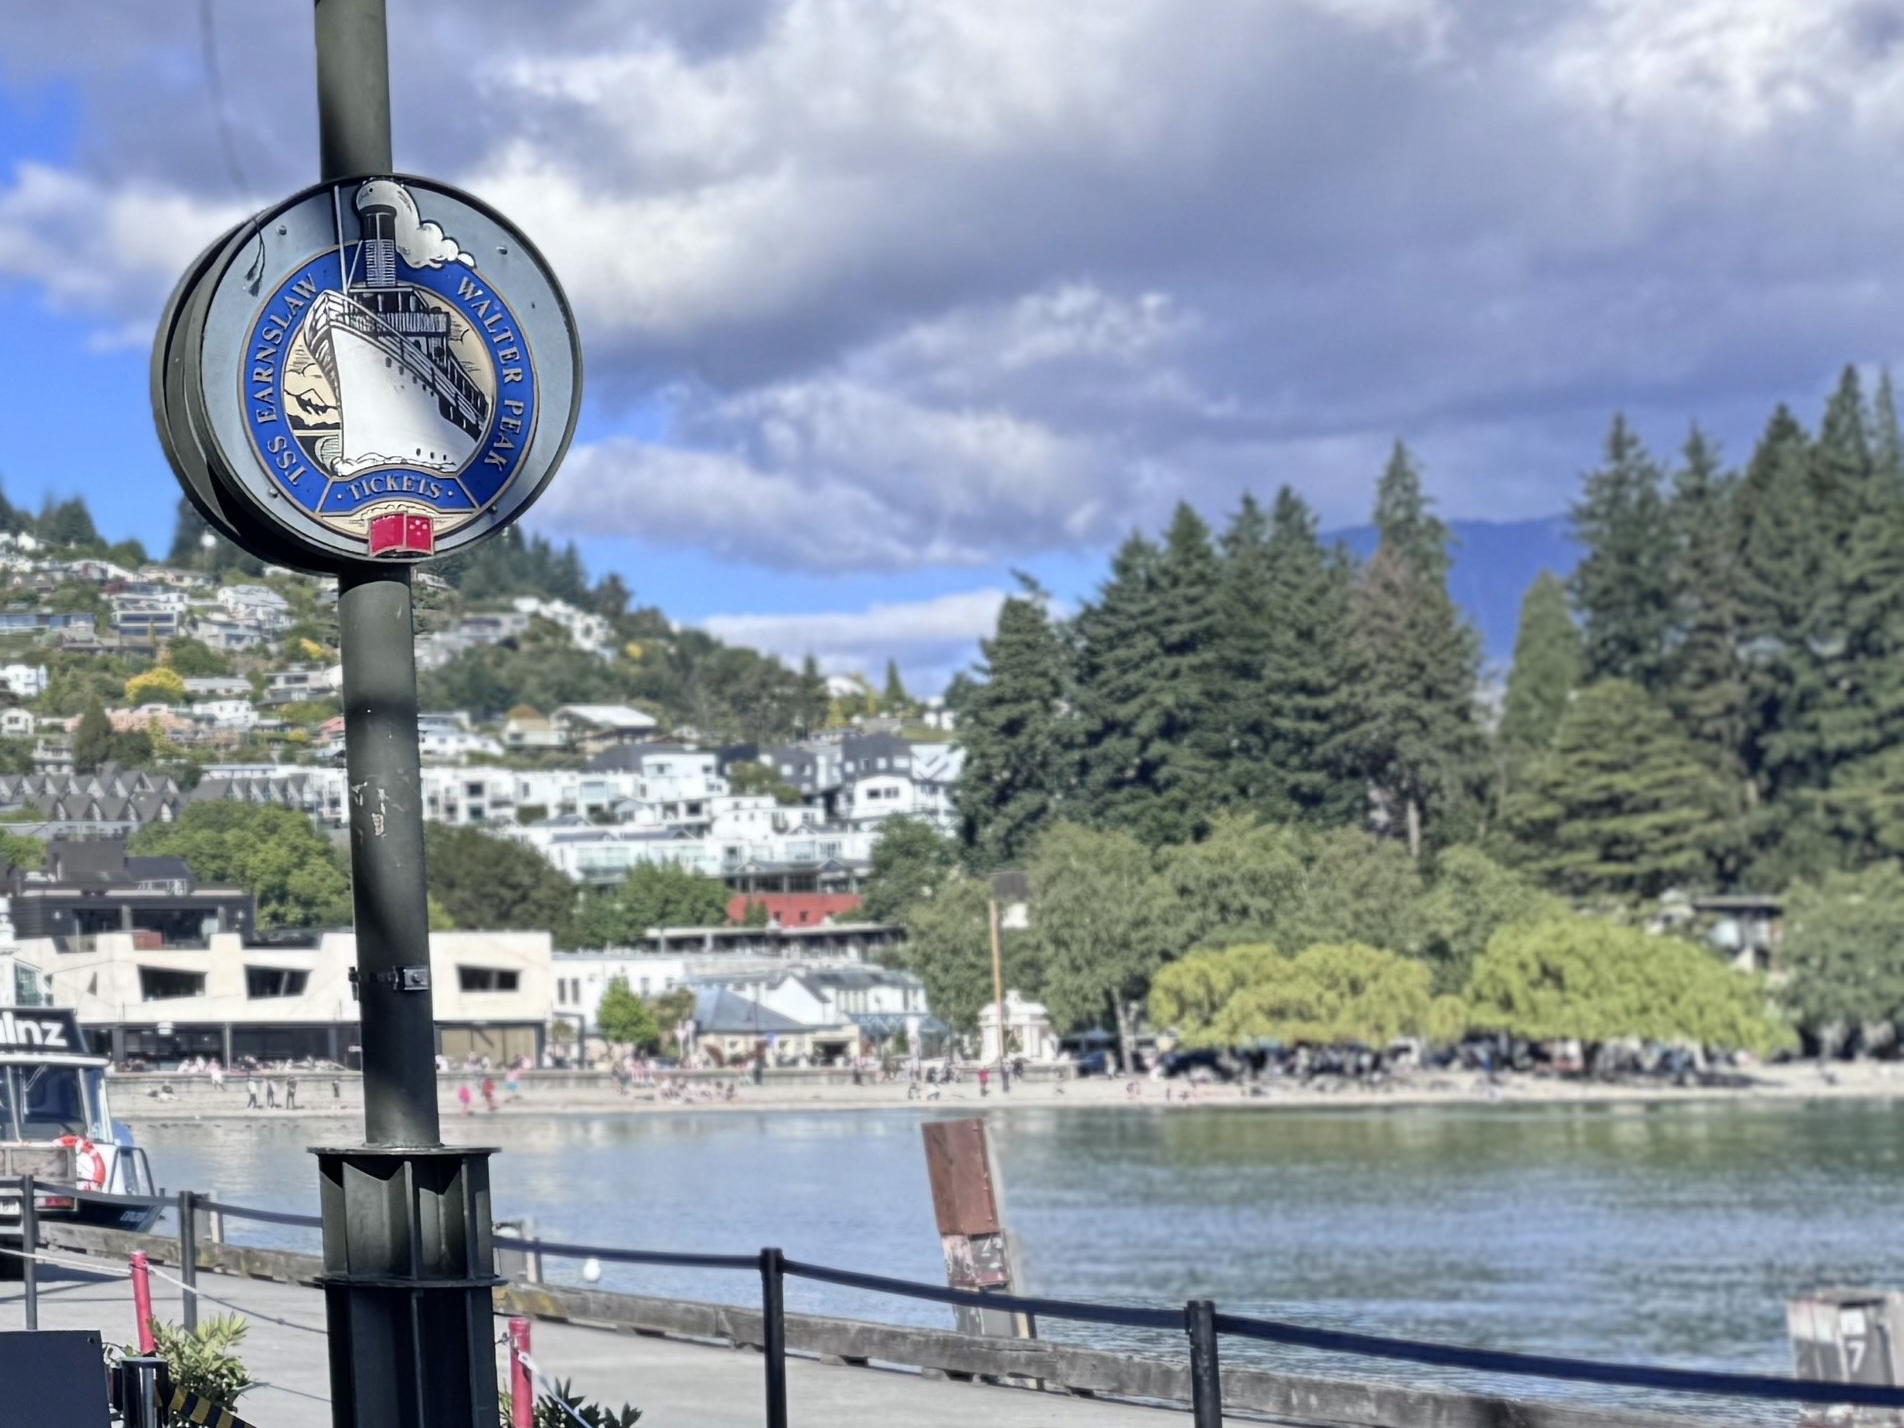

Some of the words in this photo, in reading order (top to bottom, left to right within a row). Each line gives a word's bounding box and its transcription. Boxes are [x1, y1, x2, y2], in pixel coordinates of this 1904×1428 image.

[253, 274, 318, 424] EARNSLAW
[458, 276, 523, 384] WALTER
[267, 436, 308, 486] TSS
[483, 400, 524, 472] PEAK
[347, 474, 443, 501] TICKETS
